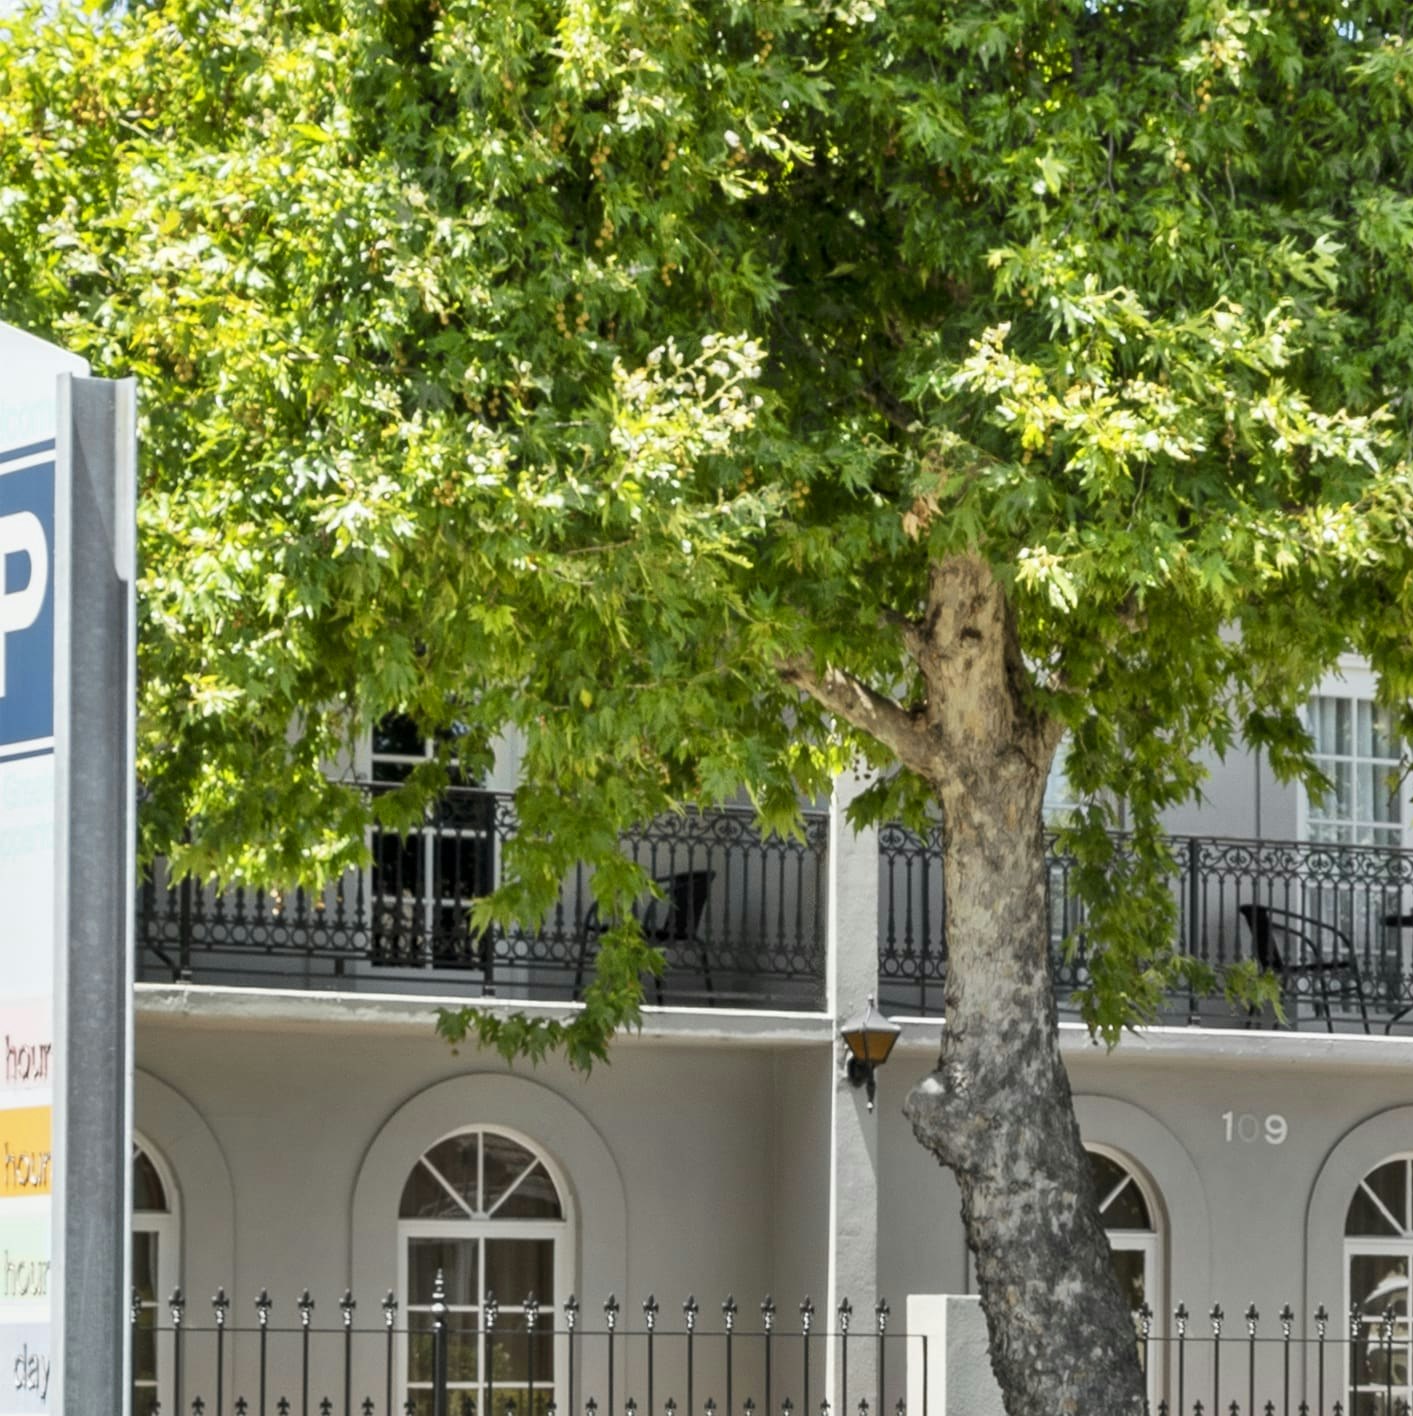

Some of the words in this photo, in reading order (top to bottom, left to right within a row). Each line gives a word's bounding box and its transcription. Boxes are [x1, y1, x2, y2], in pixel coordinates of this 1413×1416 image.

[5, 1034, 51, 1082] hour
[4, 1142, 51, 1188] hour
[14, 1343, 50, 1400] day
